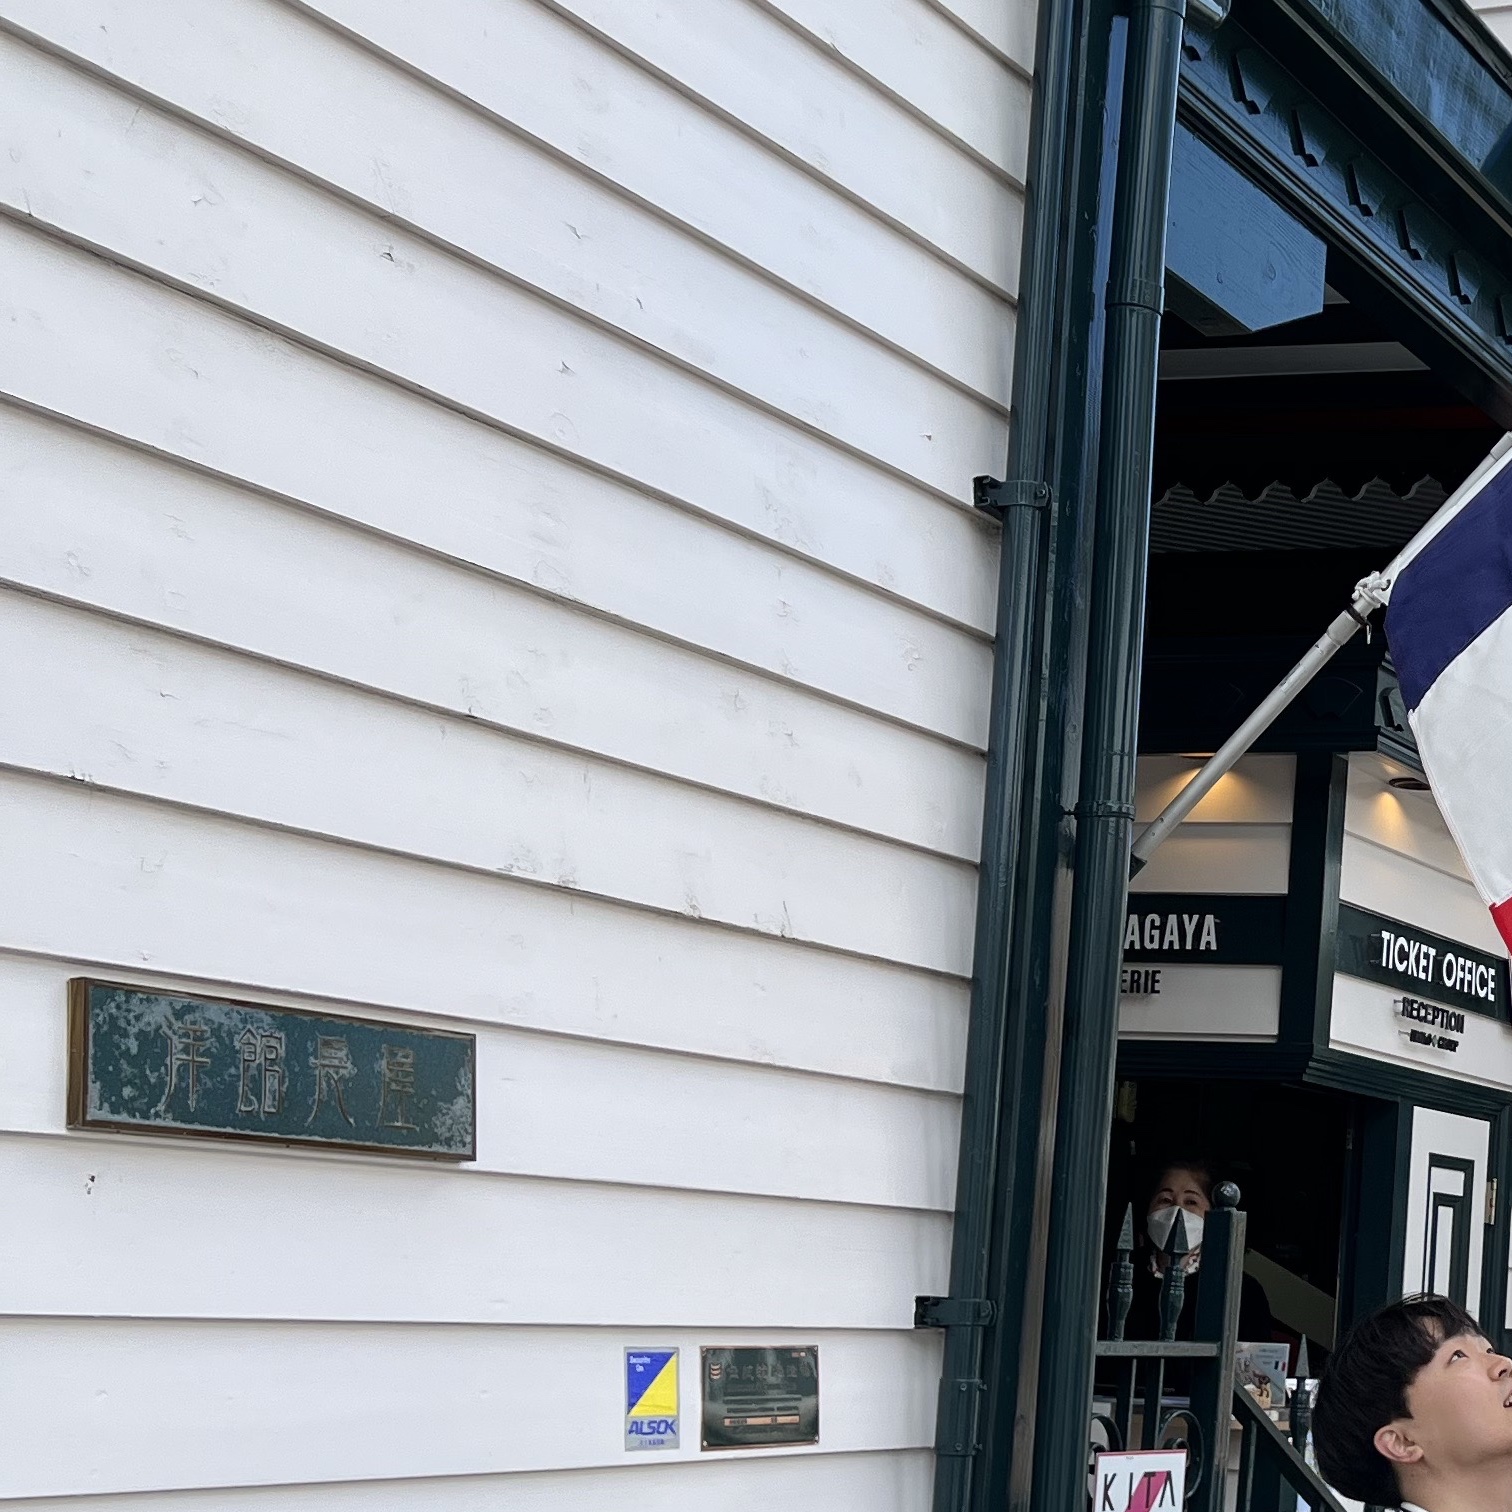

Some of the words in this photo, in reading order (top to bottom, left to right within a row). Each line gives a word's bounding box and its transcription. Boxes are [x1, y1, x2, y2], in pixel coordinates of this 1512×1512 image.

[1124, 913, 1218, 951] AGAYA
[1381, 930, 1437, 982] TICKET
[1442, 952, 1496, 1002] OFFICE
[1401, 996, 1465, 1034] RECEPTION
[157, 1014, 420, 1132] 洋館長屋
[628, 1419, 676, 1436] ALSOK
